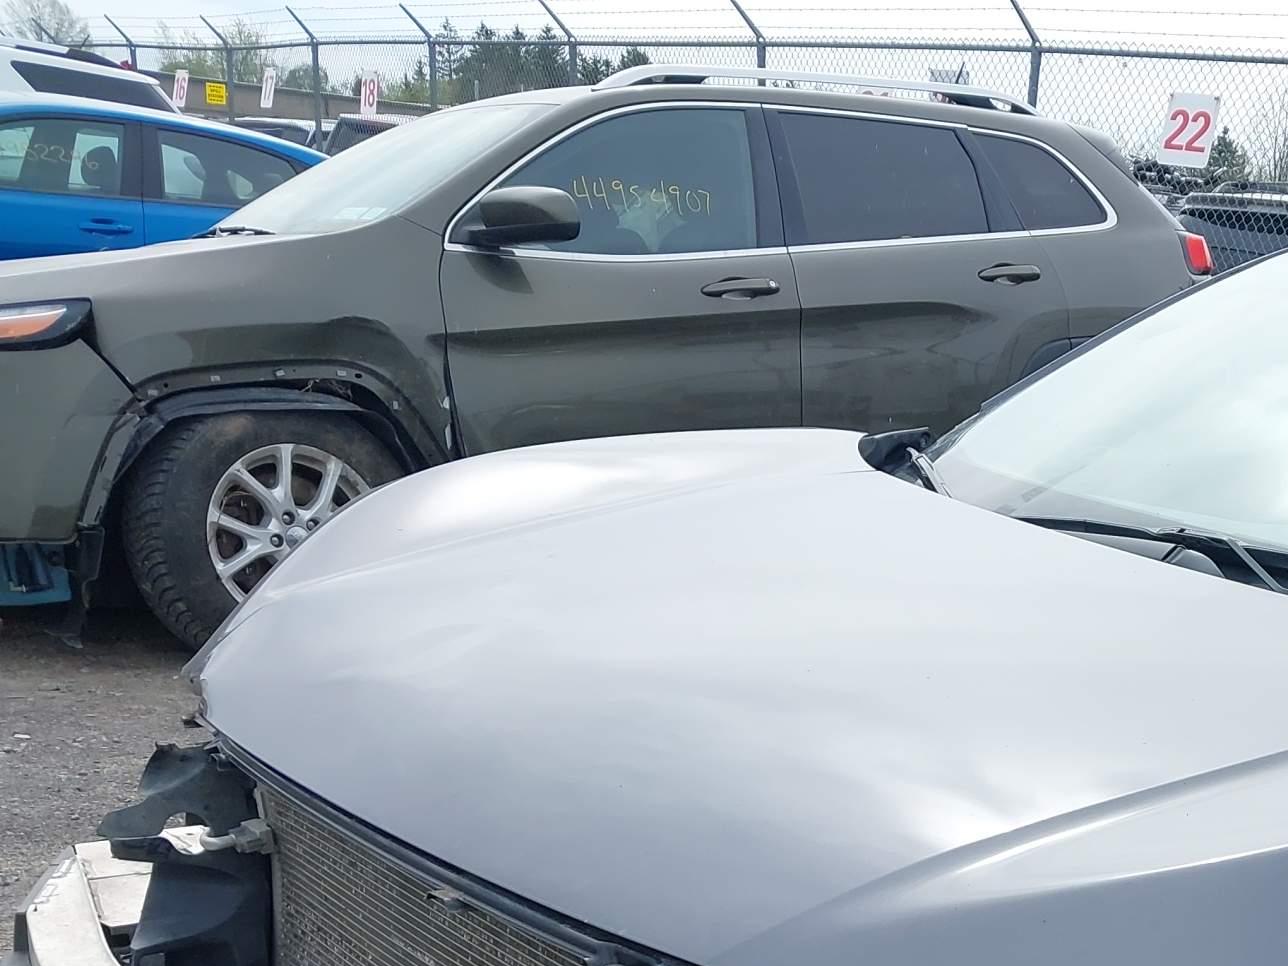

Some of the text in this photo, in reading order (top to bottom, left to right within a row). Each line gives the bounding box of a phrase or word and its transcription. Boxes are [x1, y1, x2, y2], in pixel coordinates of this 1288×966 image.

[174, 77, 187, 100] 16
[263, 74, 274, 101] 17
[362, 78, 376, 108] 18
[1163, 108, 1212, 153] 22
